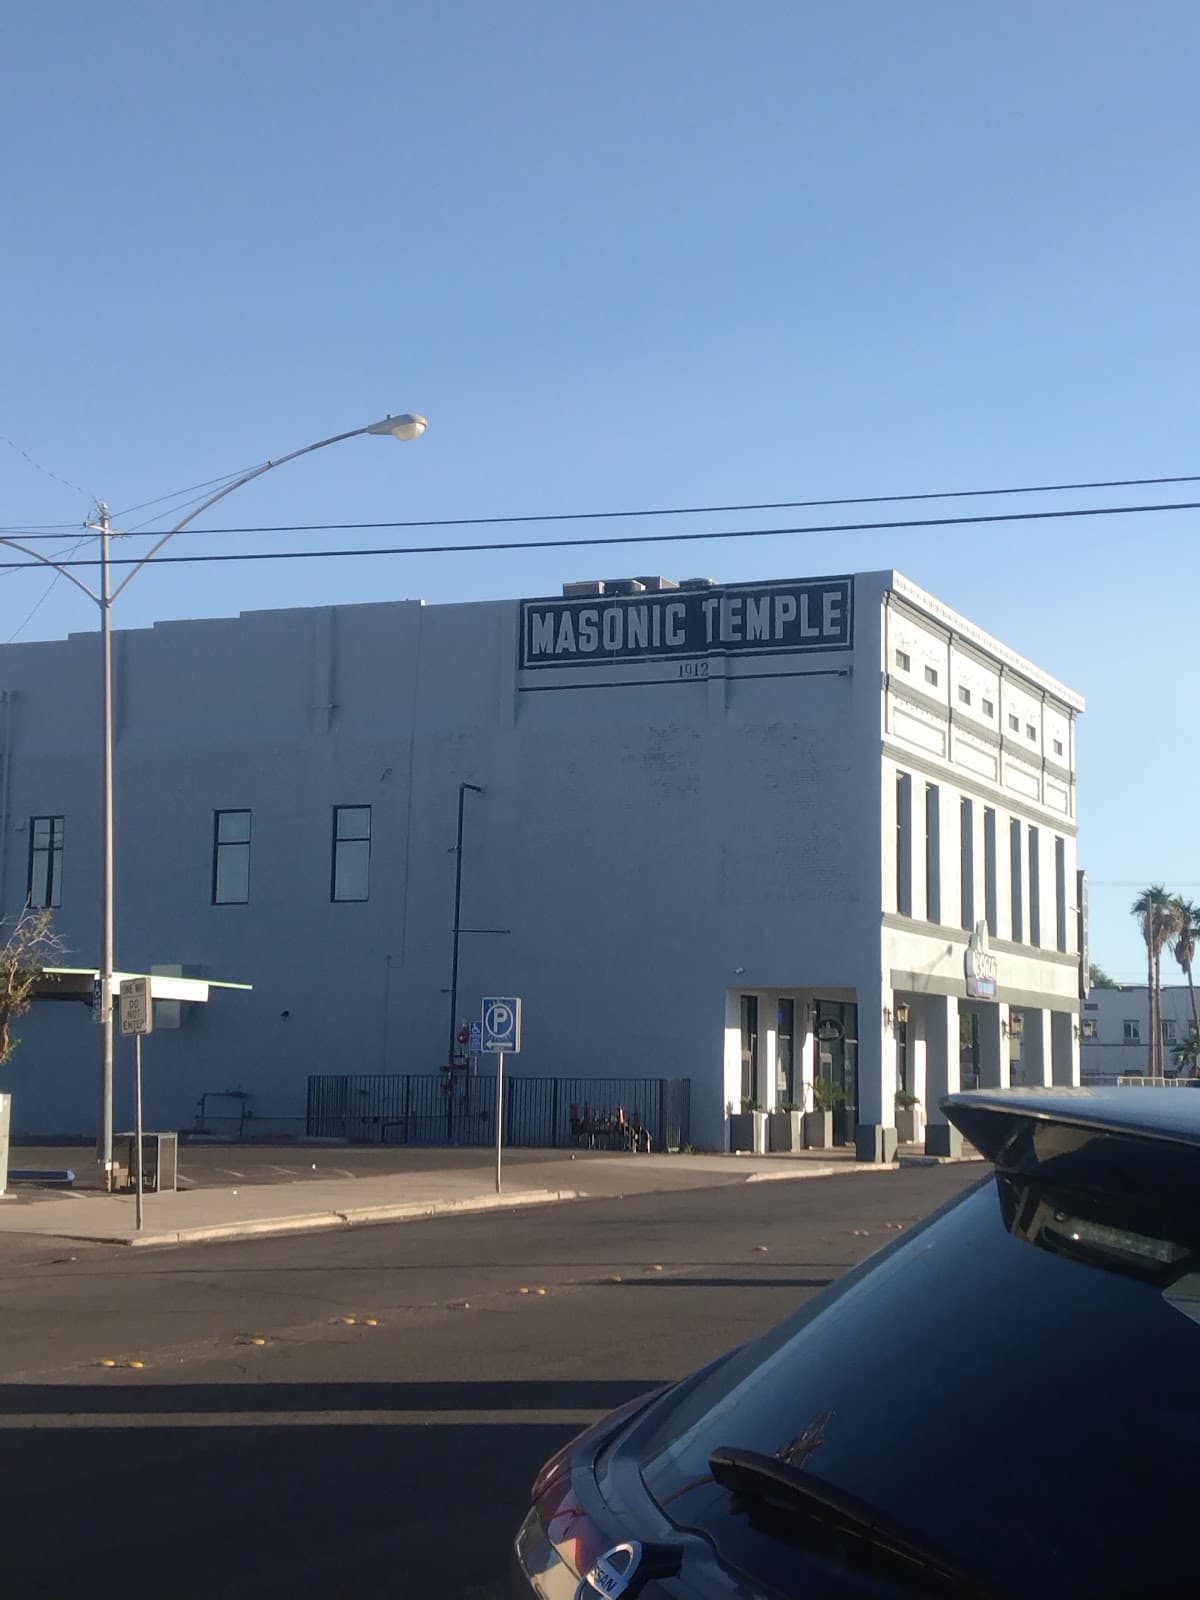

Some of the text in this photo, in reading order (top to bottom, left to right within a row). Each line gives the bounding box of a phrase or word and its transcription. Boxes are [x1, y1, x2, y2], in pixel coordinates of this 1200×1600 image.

[531, 591, 842, 655] MASONIC TEMPLE
[678, 662, 709, 678] 1912
[127, 1009, 140, 1018] NOT
[494, 1008, 507, 1032] P
